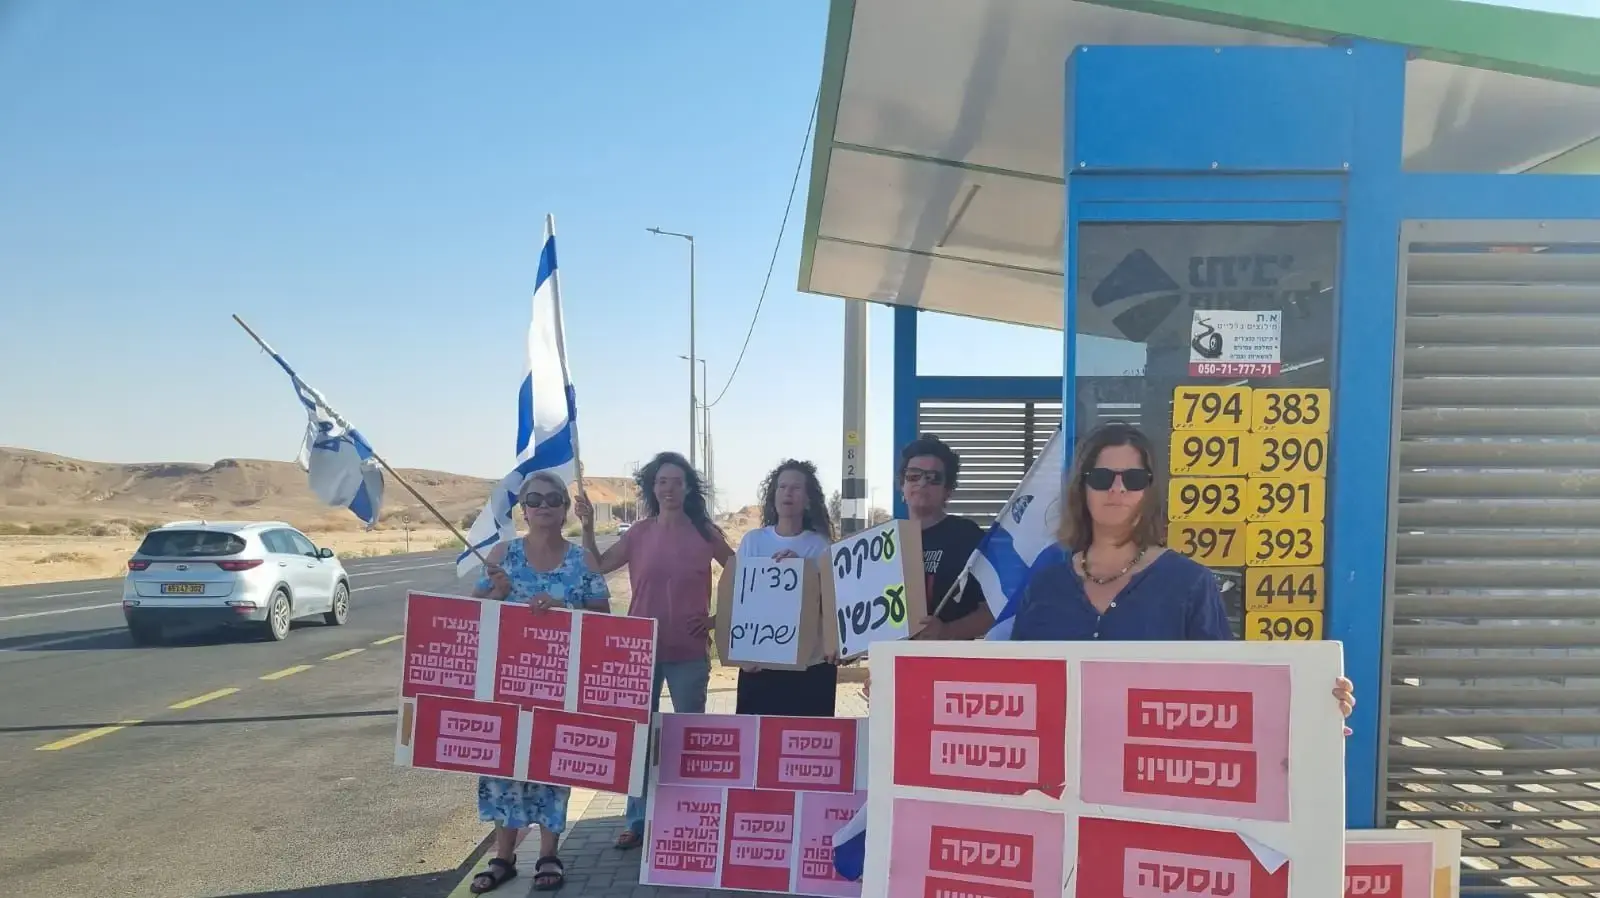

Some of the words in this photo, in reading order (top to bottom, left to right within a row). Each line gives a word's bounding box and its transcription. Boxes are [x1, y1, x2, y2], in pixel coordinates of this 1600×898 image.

[1198, 364, 1272, 375] 050-71-777-71
[1183, 392, 1243, 424] 794
[1263, 393, 1321, 425] 383
[1183, 436, 1240, 467] 991
[1260, 437, 1324, 472] 390
[1180, 483, 1241, 515] 993
[1256, 482, 1311, 514] 391
[1181, 527, 1237, 558] 397
[1255, 528, 1314, 560] 393
[834, 528, 895, 580] עסקה
[1255, 573, 1317, 605] 444
[432, 616, 480, 632] תעצרו
[1257, 616, 1314, 640] 399
[456, 631, 479, 644] את
[523, 626, 569, 642] תעצרו
[730, 623, 796, 648] שבויים
[429, 642, 477, 658] העולם
[547, 643, 569, 656] את
[605, 635, 652, 650] תעצרו
[410, 653, 476, 671] החטופות
[520, 652, 568, 669] העולם
[629, 651, 652, 664] את
[411, 669, 435, 681] שם
[501, 663, 567, 682] החטופות
[602, 661, 651, 677] העולם
[440, 671, 473, 686] עדיין
[502, 679, 525, 692] שם
[584, 673, 650, 690] החטופות
[530, 682, 564, 697] עדיין
[584, 688, 609, 701] שם
[613, 691, 648, 705] עדיין
[945, 692, 1024, 718] עסקה
[1141, 701, 1238, 730] עסקה
[448, 717, 494, 733] עסקה
[563, 731, 610, 748] עסקה
[690, 732, 734, 747] עסקה
[788, 736, 833, 751] עסקה
[443, 744, 493, 760] עכשיו!
[942, 742, 1026, 769] עכשיו!
[557, 758, 608, 776] עכשיו!
[686, 759, 734, 773] עכשיו!
[785, 763, 833, 777] עכשיו!
[1137, 757, 1241, 788] עכשיו!
[677, 801, 721, 813] תעצרו
[825, 807, 859, 821] עצרו
[699, 815, 720, 827] את
[741, 819, 785, 833] עסקה
[674, 826, 719, 840] העולם
[656, 839, 718, 853] החטופות
[736, 846, 785, 861] עכשיו!
[942, 838, 1021, 868] עסקה
[656, 855, 679, 866] שם
[683, 855, 716, 869] עדיין
[803, 863, 828, 877] שם
[1138, 861, 1235, 897] עסקה
[1345, 875, 1391, 895] עס
